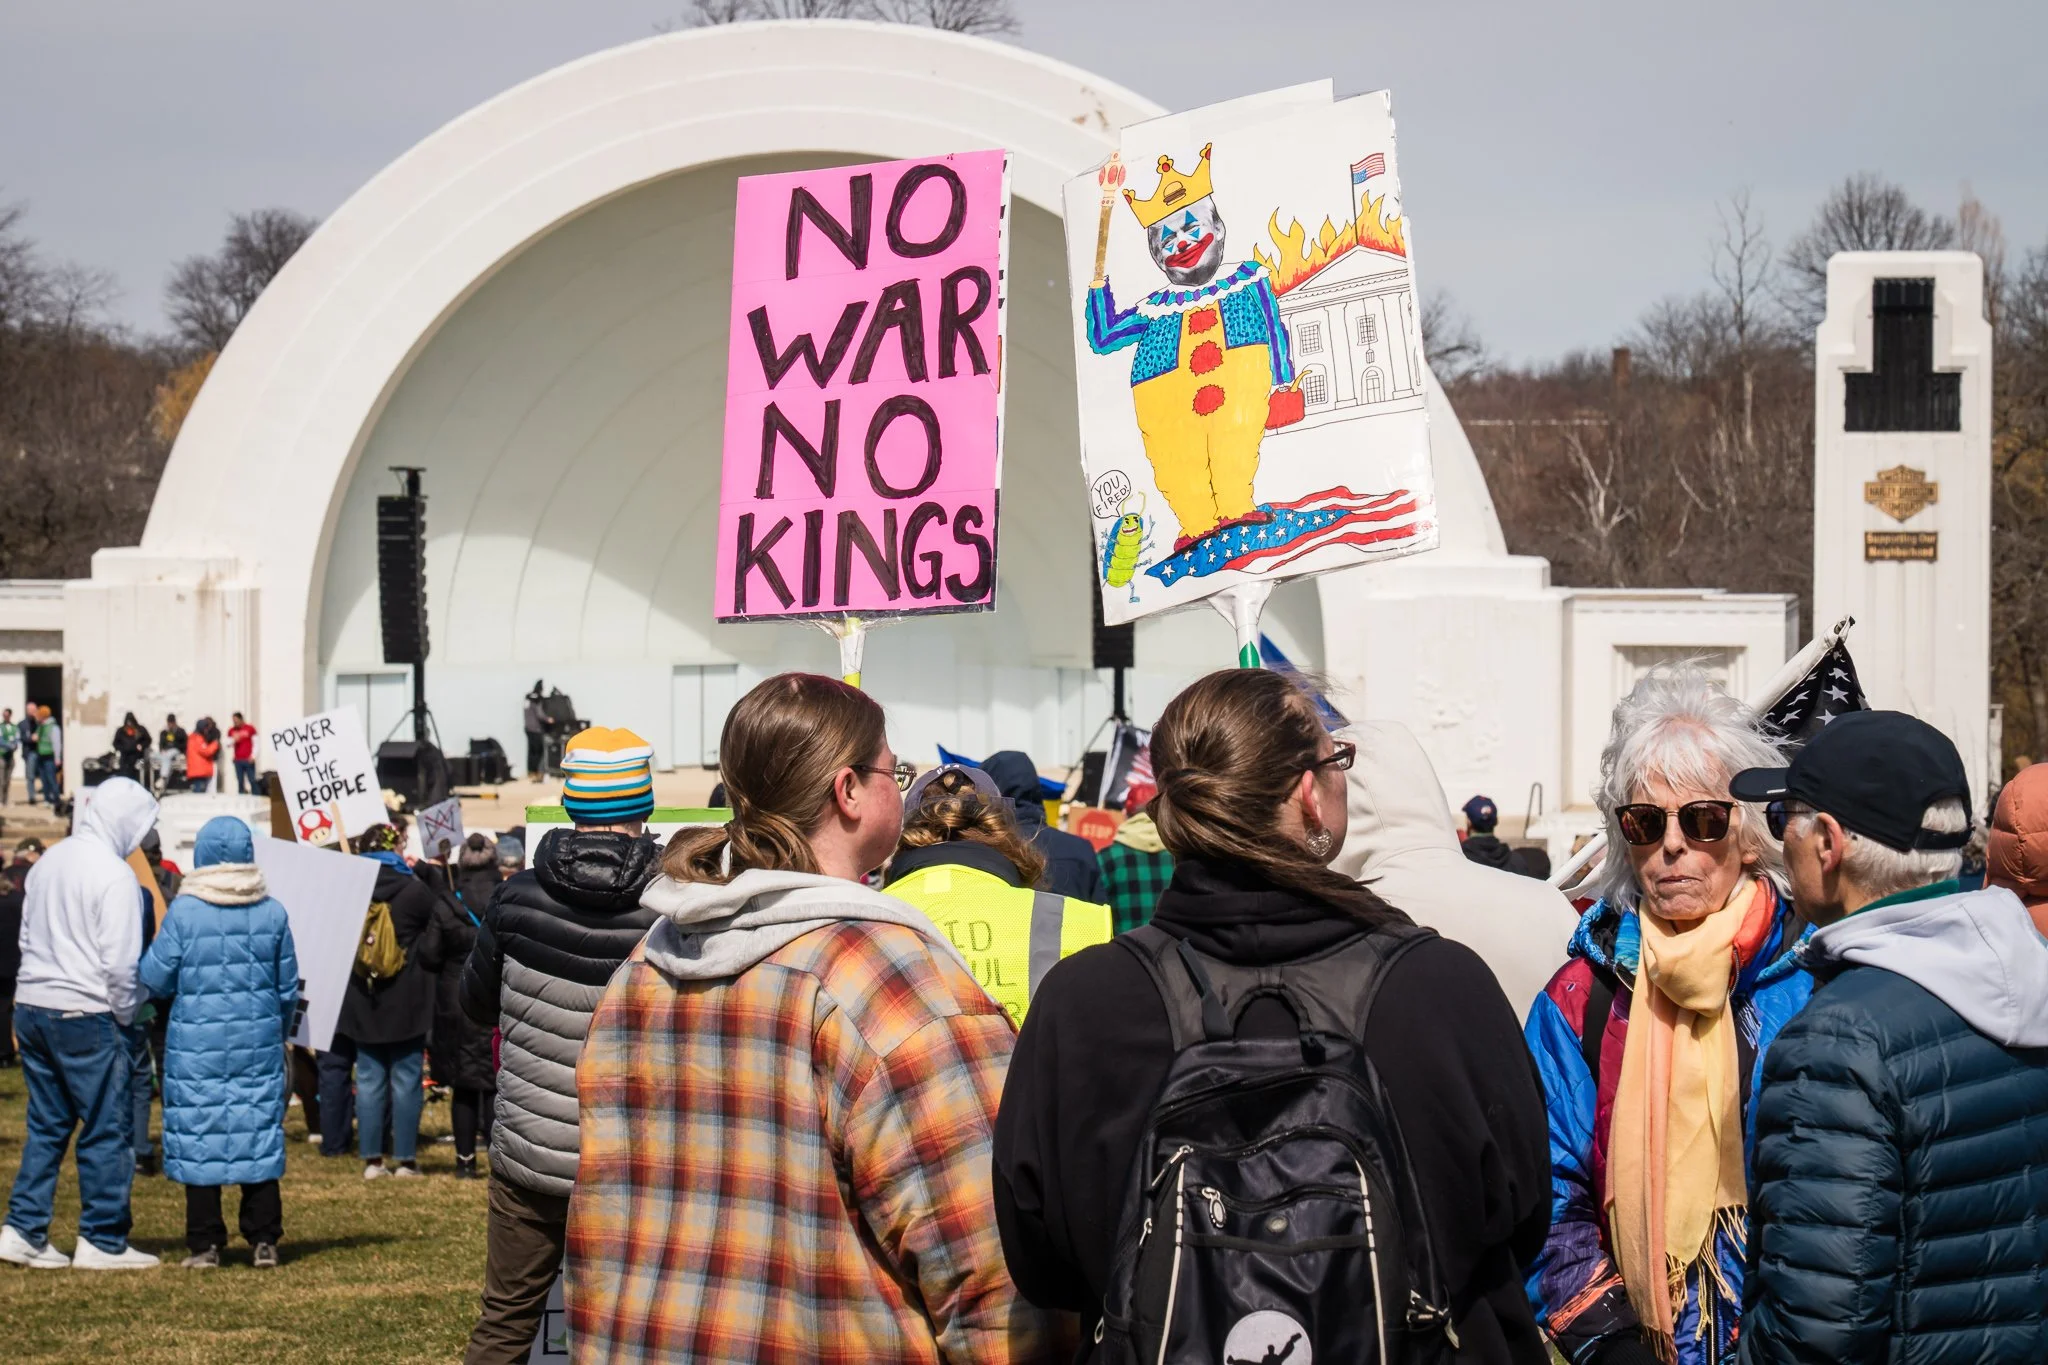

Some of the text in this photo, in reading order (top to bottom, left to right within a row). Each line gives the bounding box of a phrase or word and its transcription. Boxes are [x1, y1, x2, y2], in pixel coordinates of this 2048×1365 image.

[785, 163, 967, 281] NO
[747, 265, 992, 390] WAR
[754, 394, 942, 500] NO
[1094, 475, 1120, 502] YOU
[1095, 484, 1130, 516] FIRED!
[733, 501, 992, 614] KINGS
[272, 718, 335, 751] POWER
[296, 744, 320, 765] UP
[302, 760, 339, 785] THE
[297, 773, 366, 809] PEOPLE
